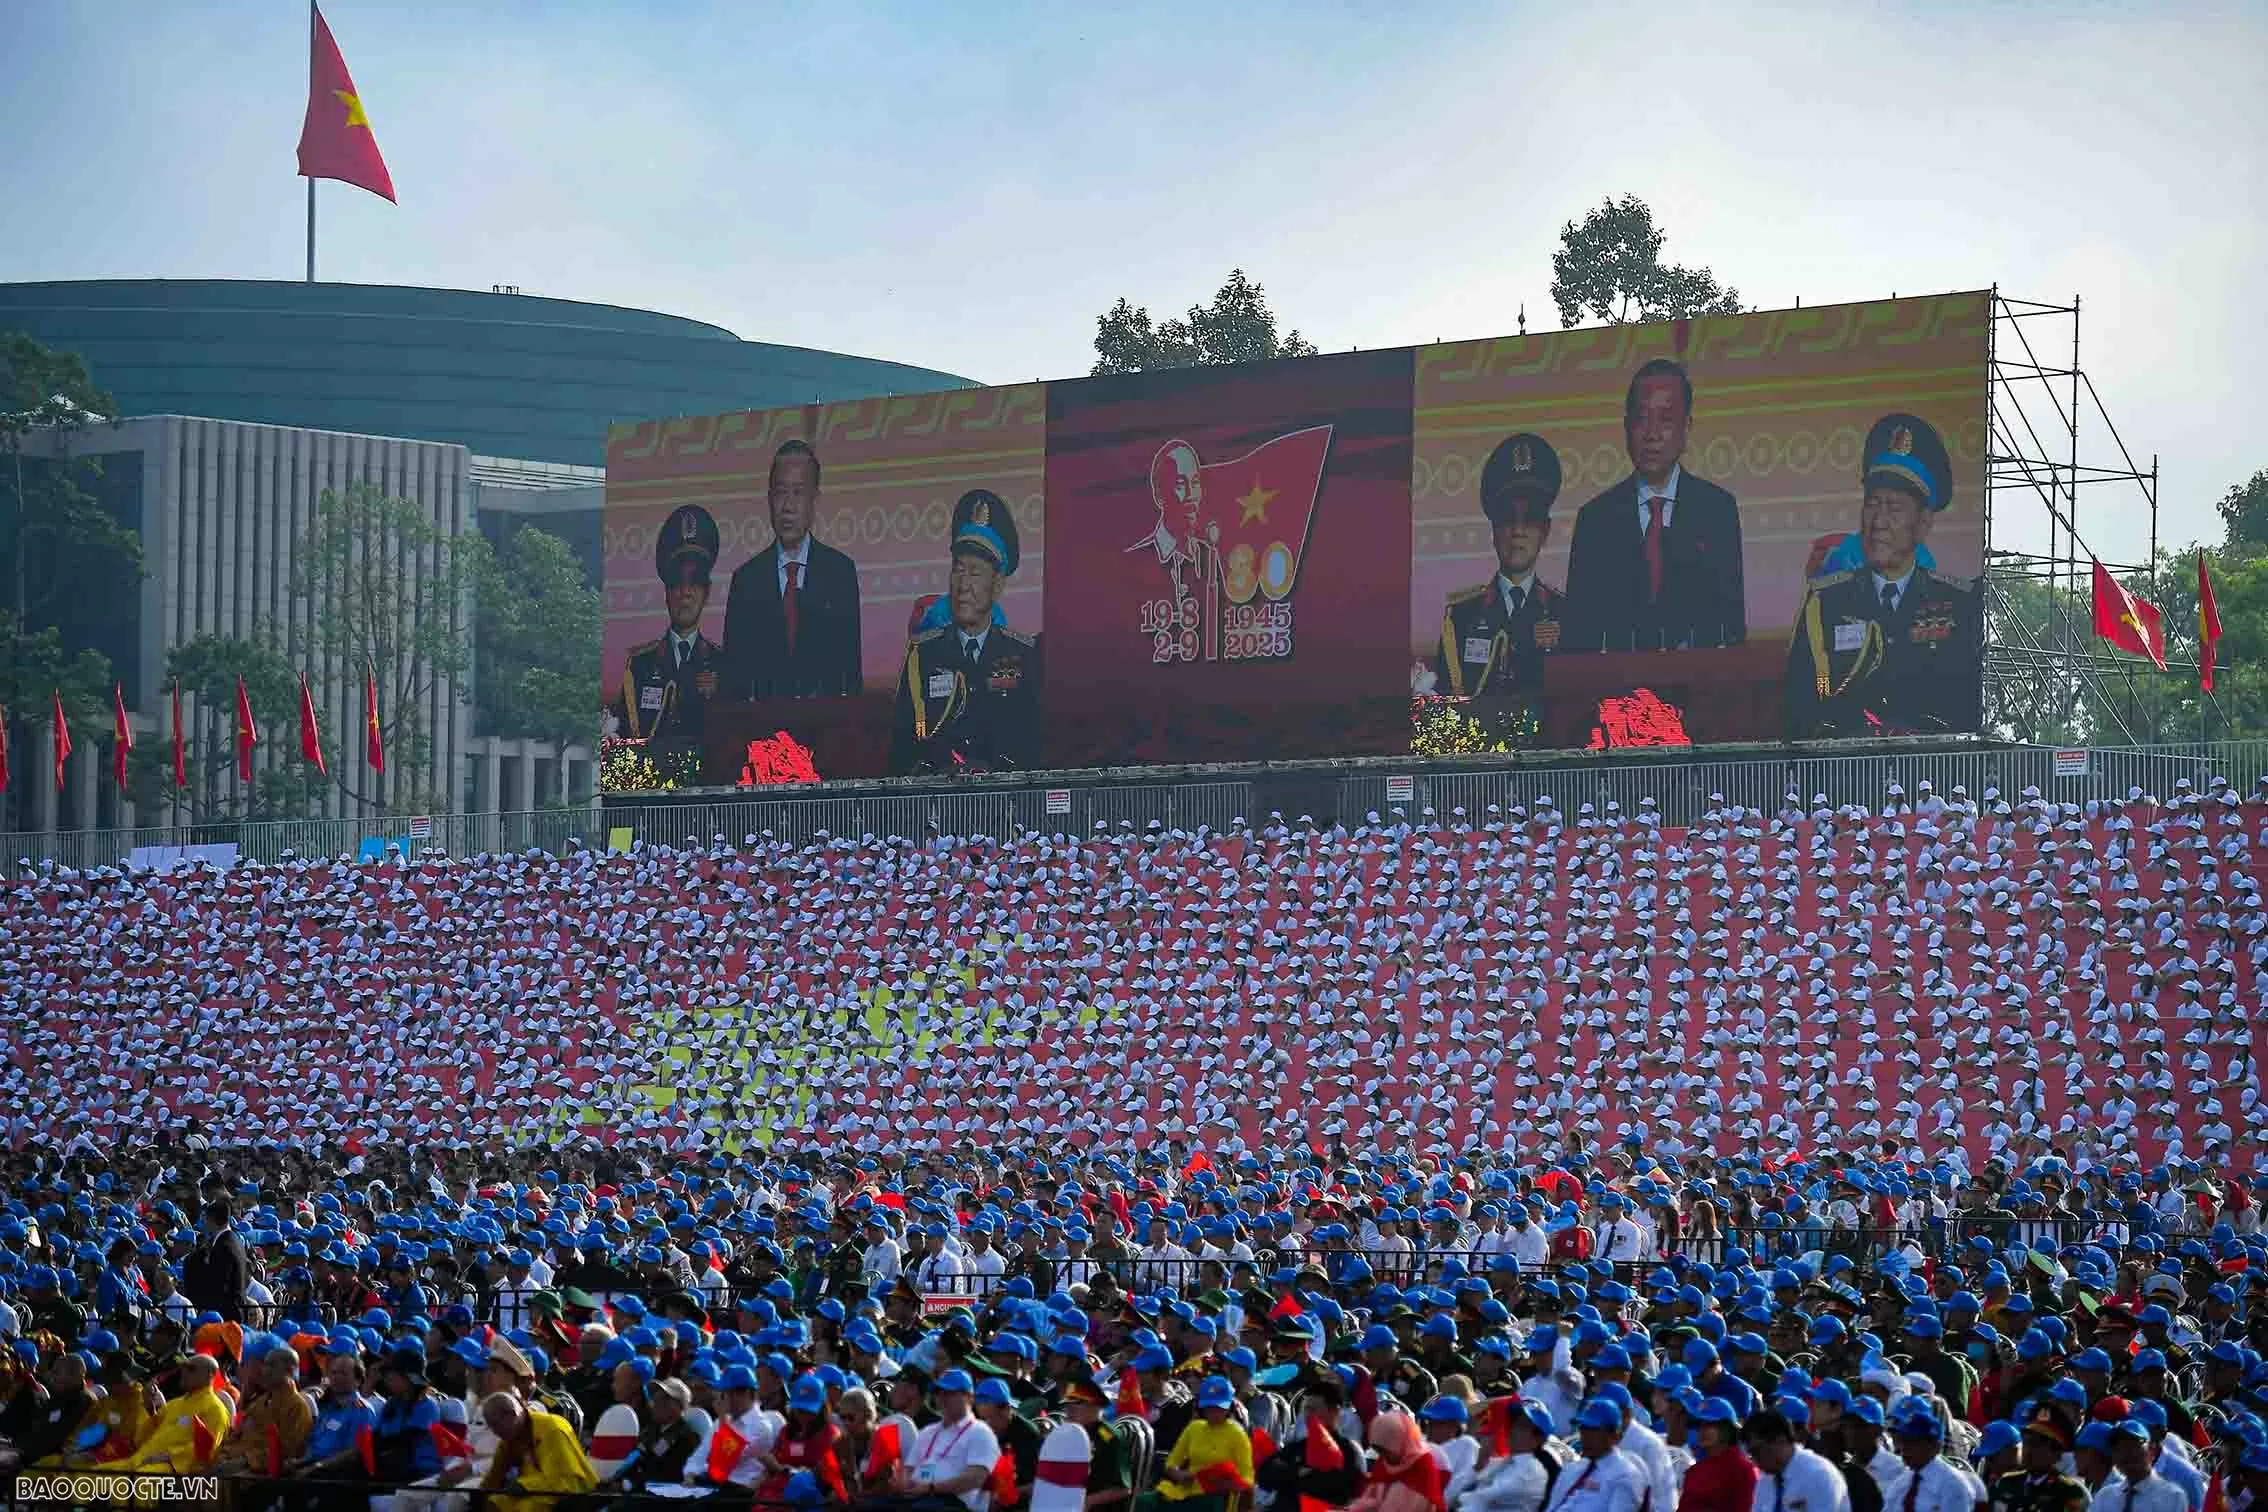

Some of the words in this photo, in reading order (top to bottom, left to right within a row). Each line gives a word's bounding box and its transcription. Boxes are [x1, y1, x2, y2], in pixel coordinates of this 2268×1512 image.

[1226, 542, 1293, 604] 80
[1140, 598, 1200, 632] 19-8
[1224, 602, 1292, 631] 1945
[1153, 630, 1200, 663] 2-9
[1224, 630, 1292, 659] 2025
